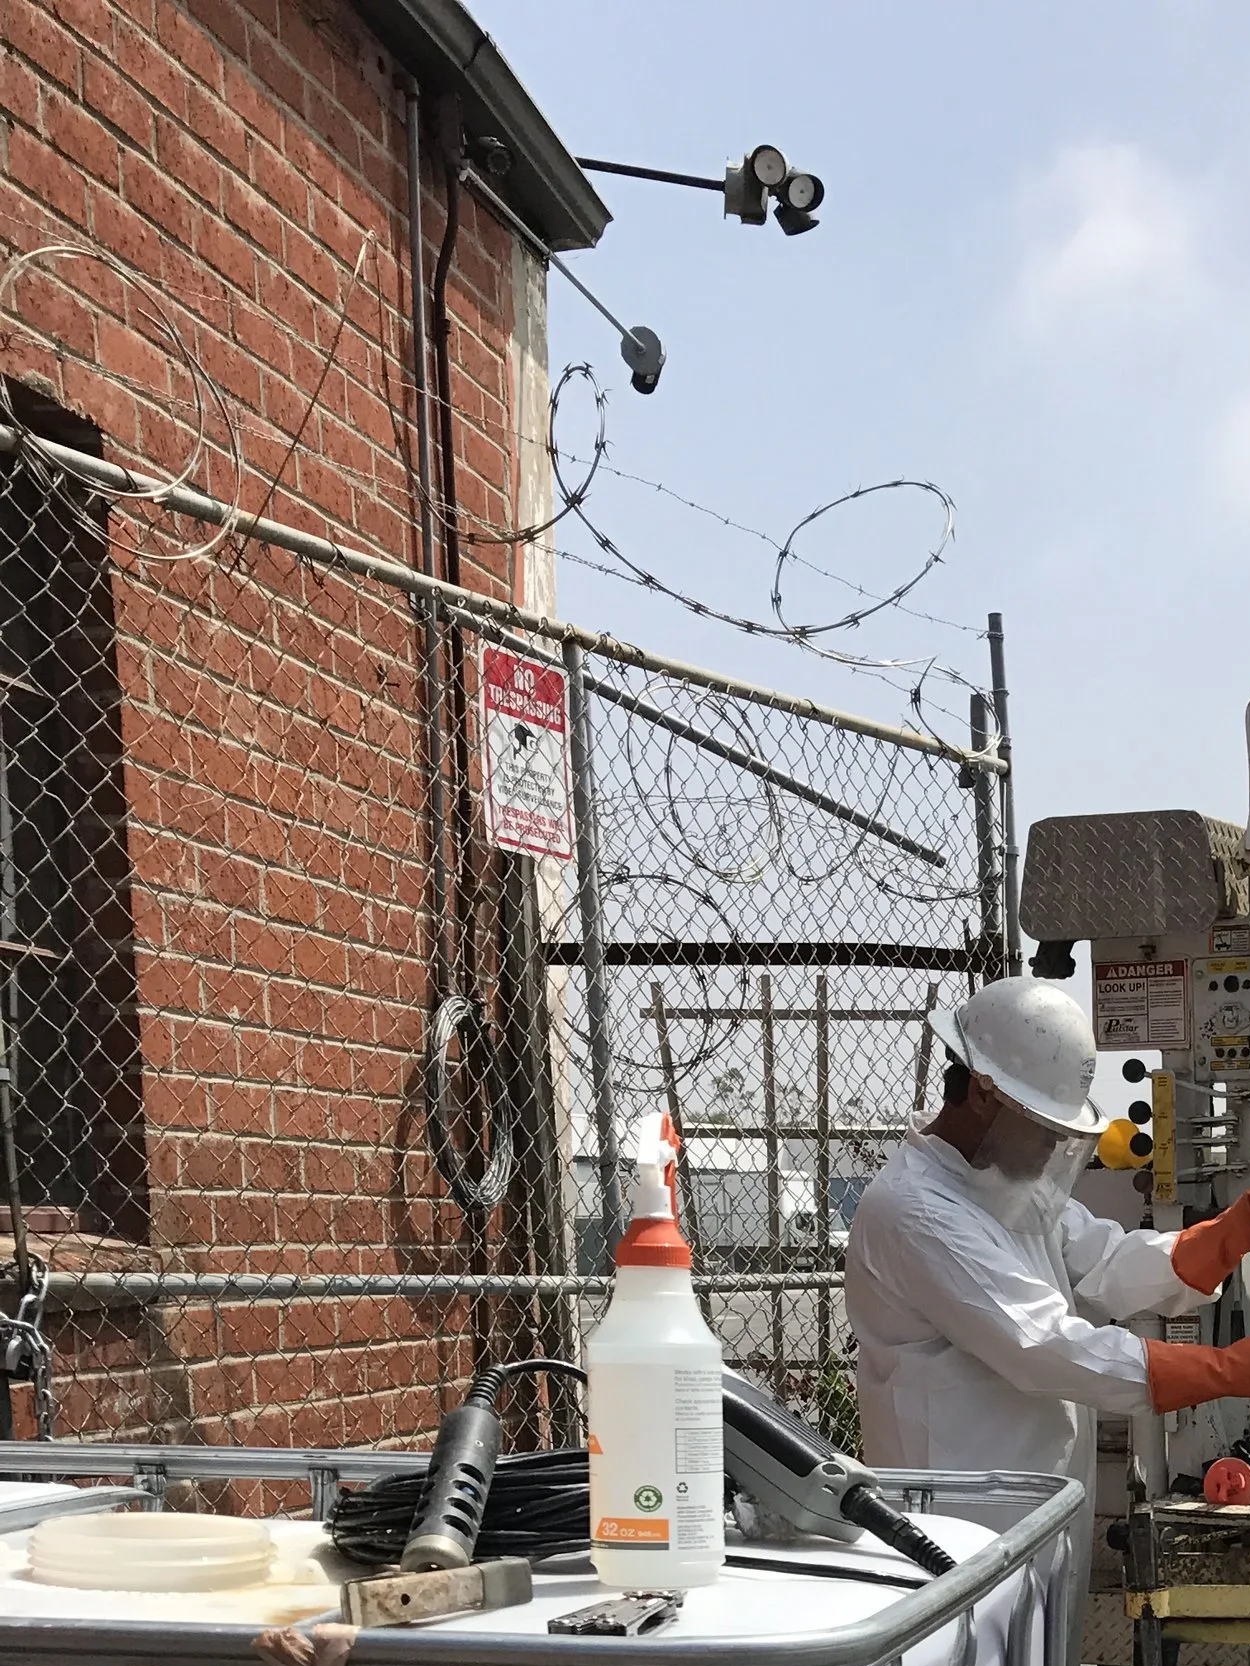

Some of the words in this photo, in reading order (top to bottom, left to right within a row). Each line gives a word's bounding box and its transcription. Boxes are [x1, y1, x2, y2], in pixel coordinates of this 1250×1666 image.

[513, 664, 535, 694] NO
[488, 683, 562, 725] TRESPASSING
[505, 762, 519, 774] THIS
[521, 766, 553, 782] POPERTY
[498, 783, 515, 797] VIDE
[1118, 963, 1174, 978] DANGER
[1098, 983, 1127, 994] LOOK
[1128, 982, 1146, 992] UP!
[1104, 1018, 1140, 1034] Pulstar
[602, 1521, 618, 1537] 32
